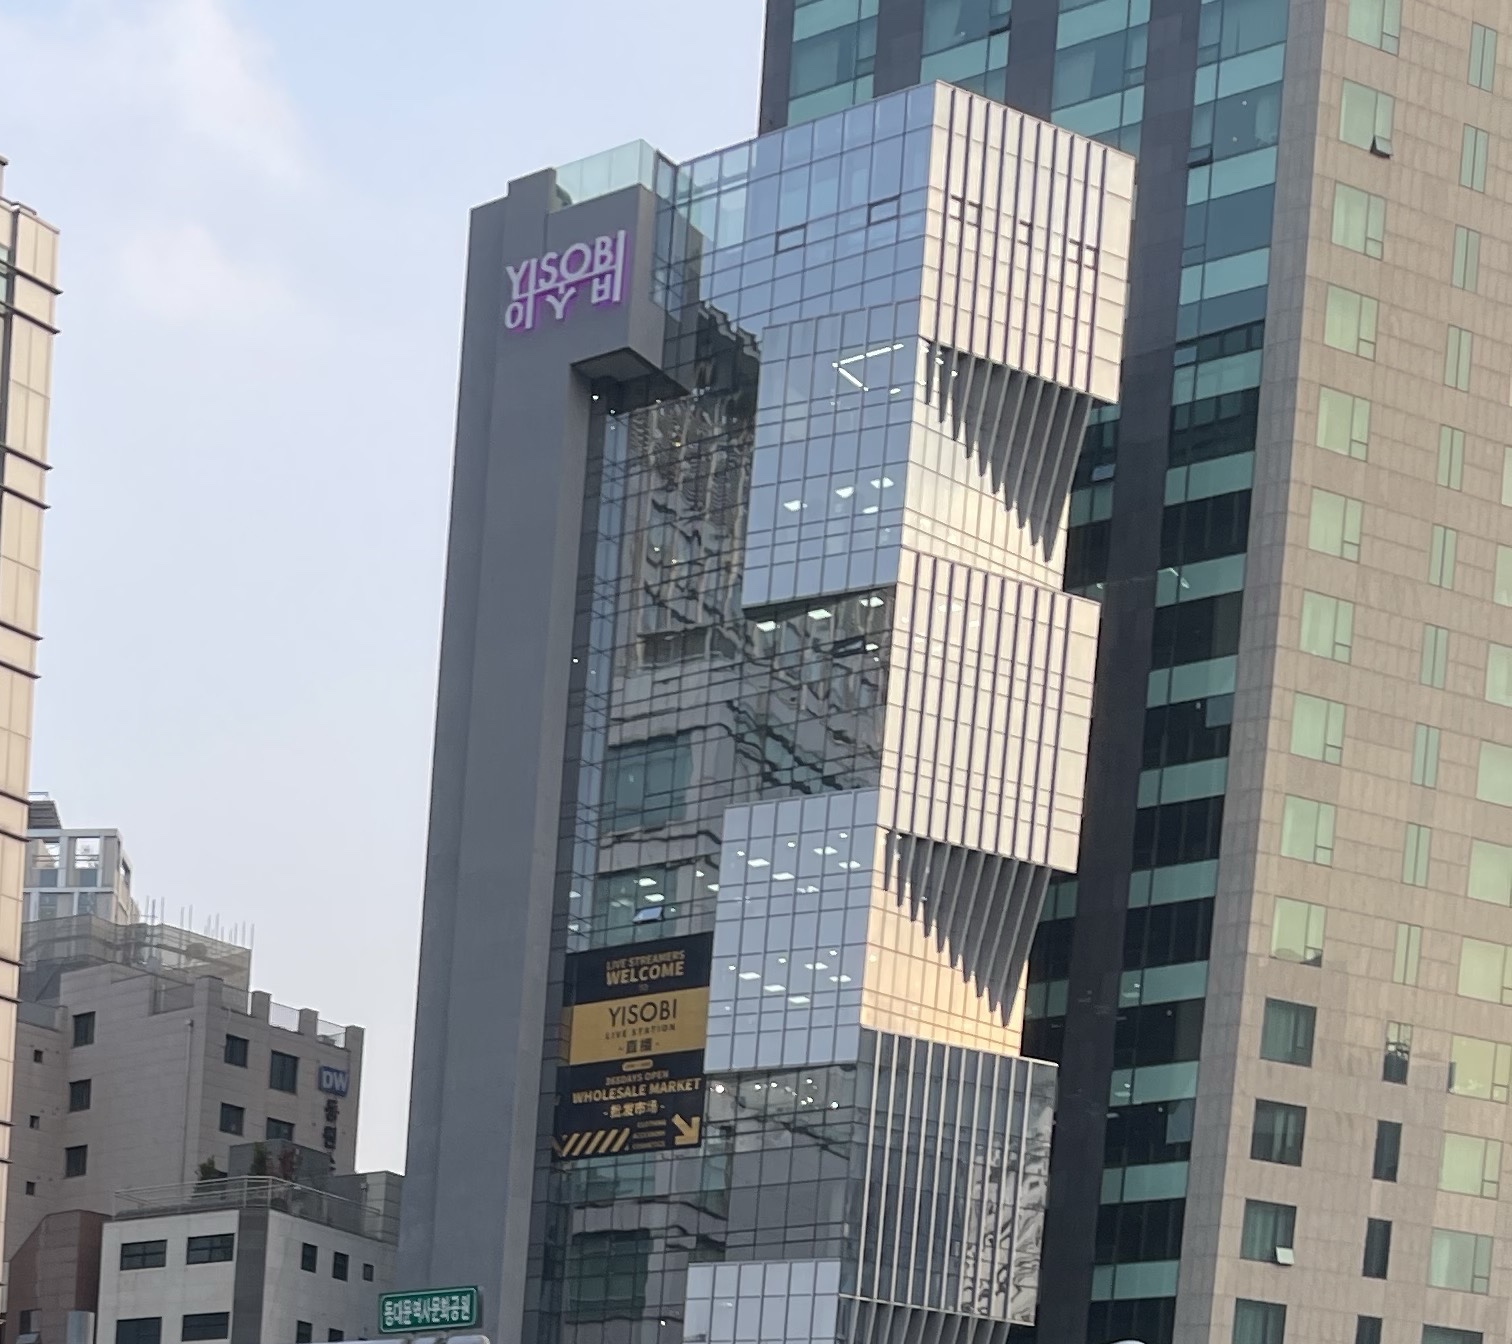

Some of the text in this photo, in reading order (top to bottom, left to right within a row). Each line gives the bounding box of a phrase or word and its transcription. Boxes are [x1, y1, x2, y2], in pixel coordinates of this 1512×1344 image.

[505, 230, 626, 300] YISOBI
[607, 961, 684, 985] WELCOME
[609, 999, 677, 1026] YISOBI
[632, 1023, 675, 1036] STATION
[322, 1070, 347, 1092] DW
[572, 1078, 702, 1104] WHOLESALE MARKET
[384, 1294, 471, 1326] 동대문역사문화공원
